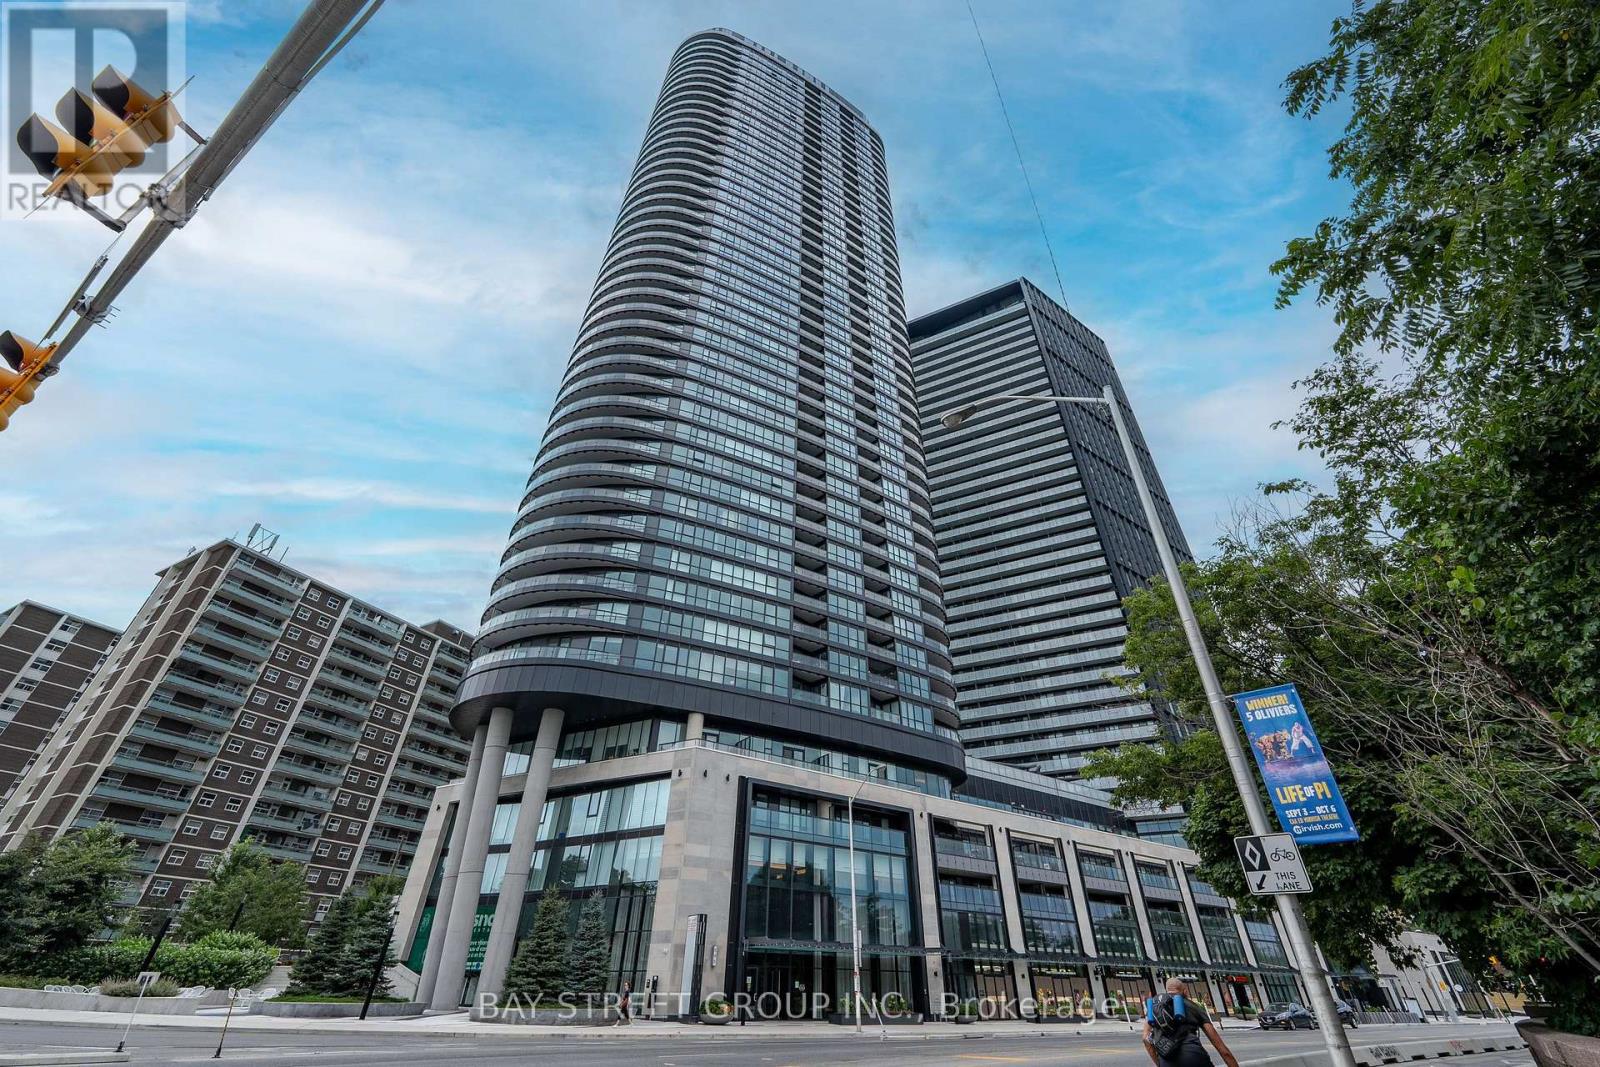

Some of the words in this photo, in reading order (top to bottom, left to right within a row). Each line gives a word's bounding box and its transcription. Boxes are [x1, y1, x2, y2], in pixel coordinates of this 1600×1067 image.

[1245, 694, 1289, 711] WINNER!
[1246, 712, 1254, 721] 5
[1255, 704, 1297, 720] OLIVIERS
[1275, 784, 1307, 804] LIFE
[1303, 786, 1315, 797] OF
[1313, 781, 1332, 799] PI
[1285, 808, 1302, 818] SEPT
[1302, 808, 1308, 816] 3
[1315, 805, 1330, 814] OCT
[1330, 804, 1337, 813] 6
[1275, 872, 1296, 880] THIS
[1276, 882, 1302, 890] LANE
